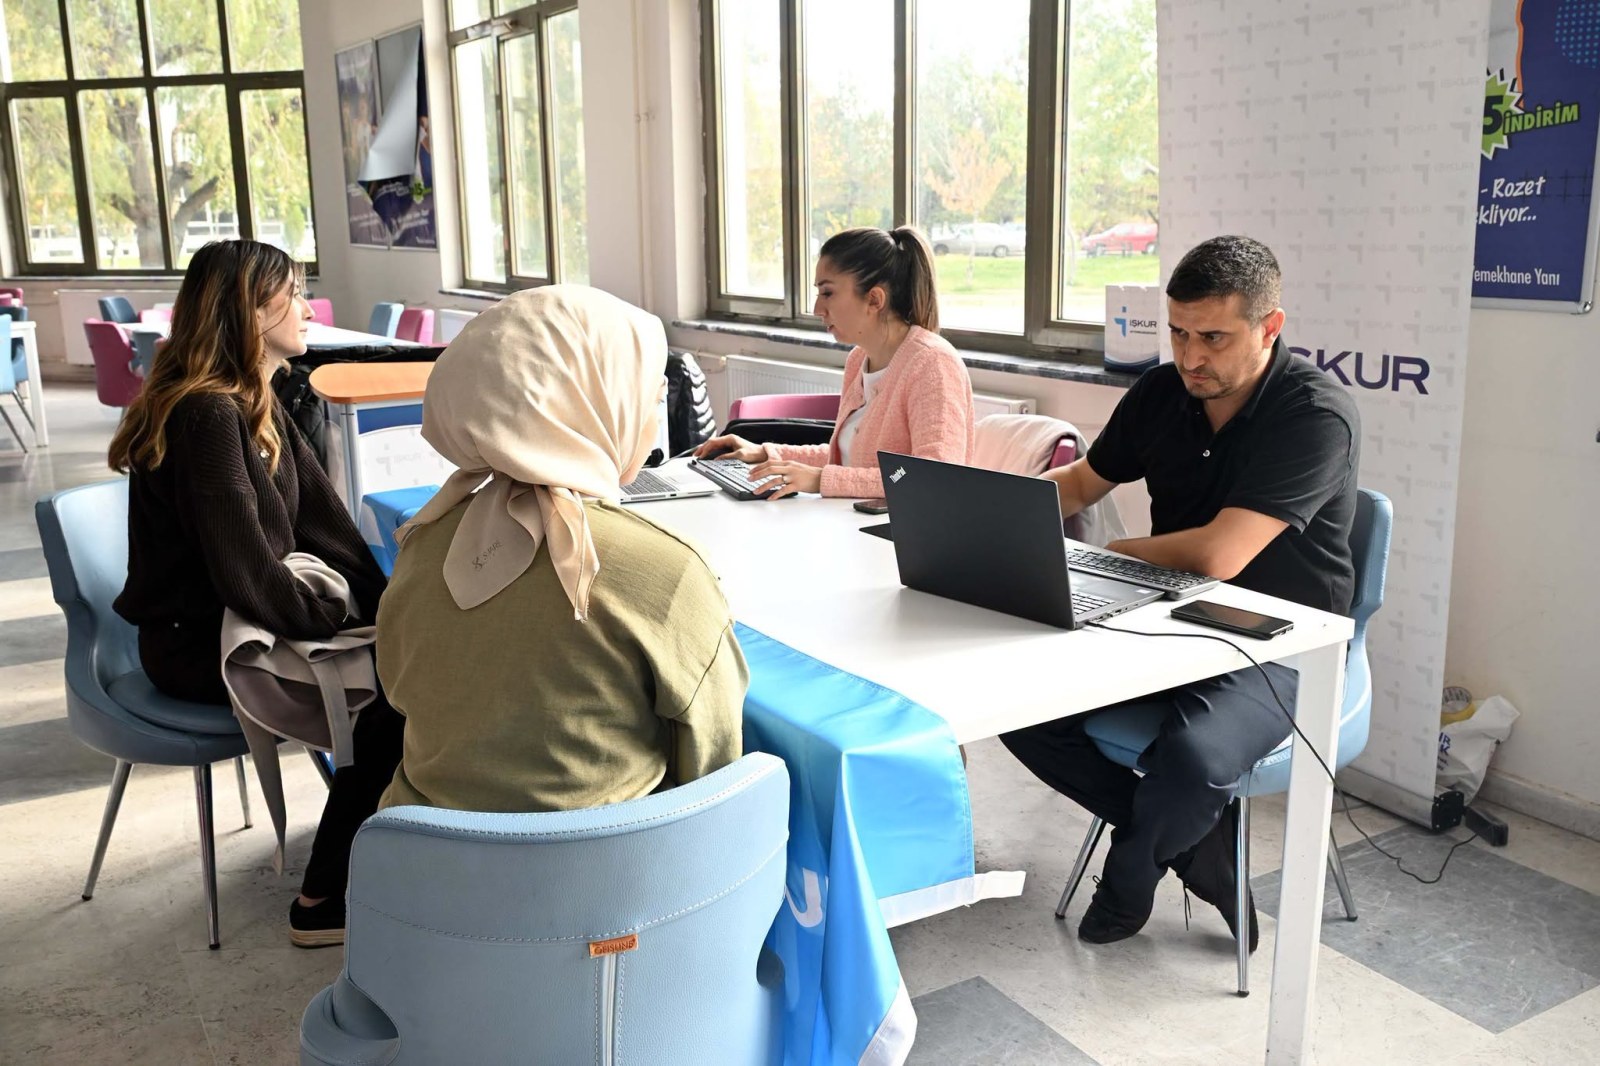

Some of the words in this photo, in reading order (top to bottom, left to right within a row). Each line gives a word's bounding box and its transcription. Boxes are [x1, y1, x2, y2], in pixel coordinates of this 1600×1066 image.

[1503, 101, 1579, 134] İNDİRİM
[1492, 176, 1546, 198] Rozet
[1476, 204, 1537, 227] kliyor...
[1473, 265, 1531, 284] emekhane
[1534, 268, 1560, 286] Yanı
